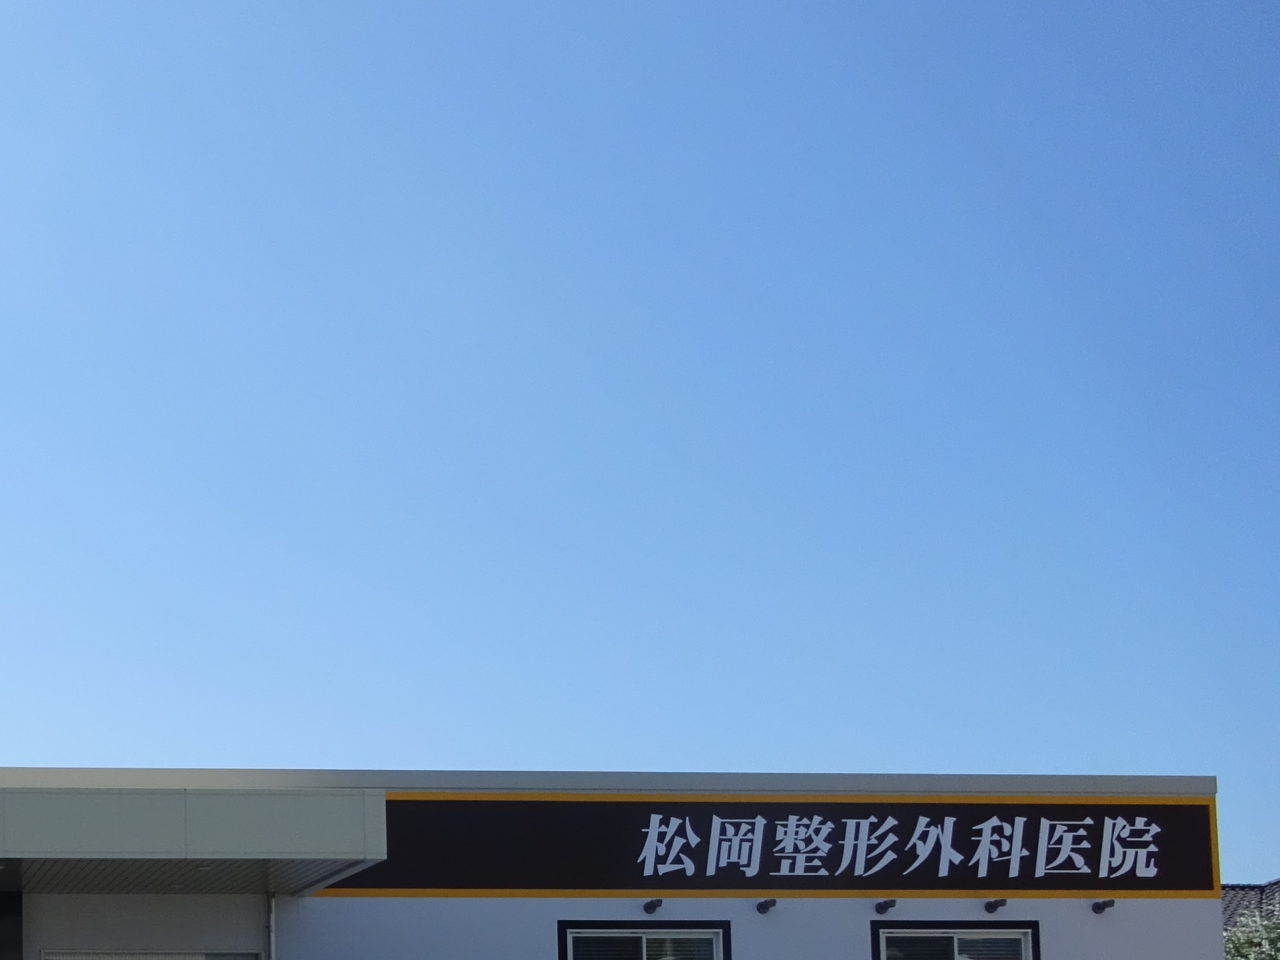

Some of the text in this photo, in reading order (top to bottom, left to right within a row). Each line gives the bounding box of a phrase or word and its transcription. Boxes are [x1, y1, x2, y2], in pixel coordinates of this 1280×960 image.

[636, 813, 1162, 879] 松岡整形外科医院
